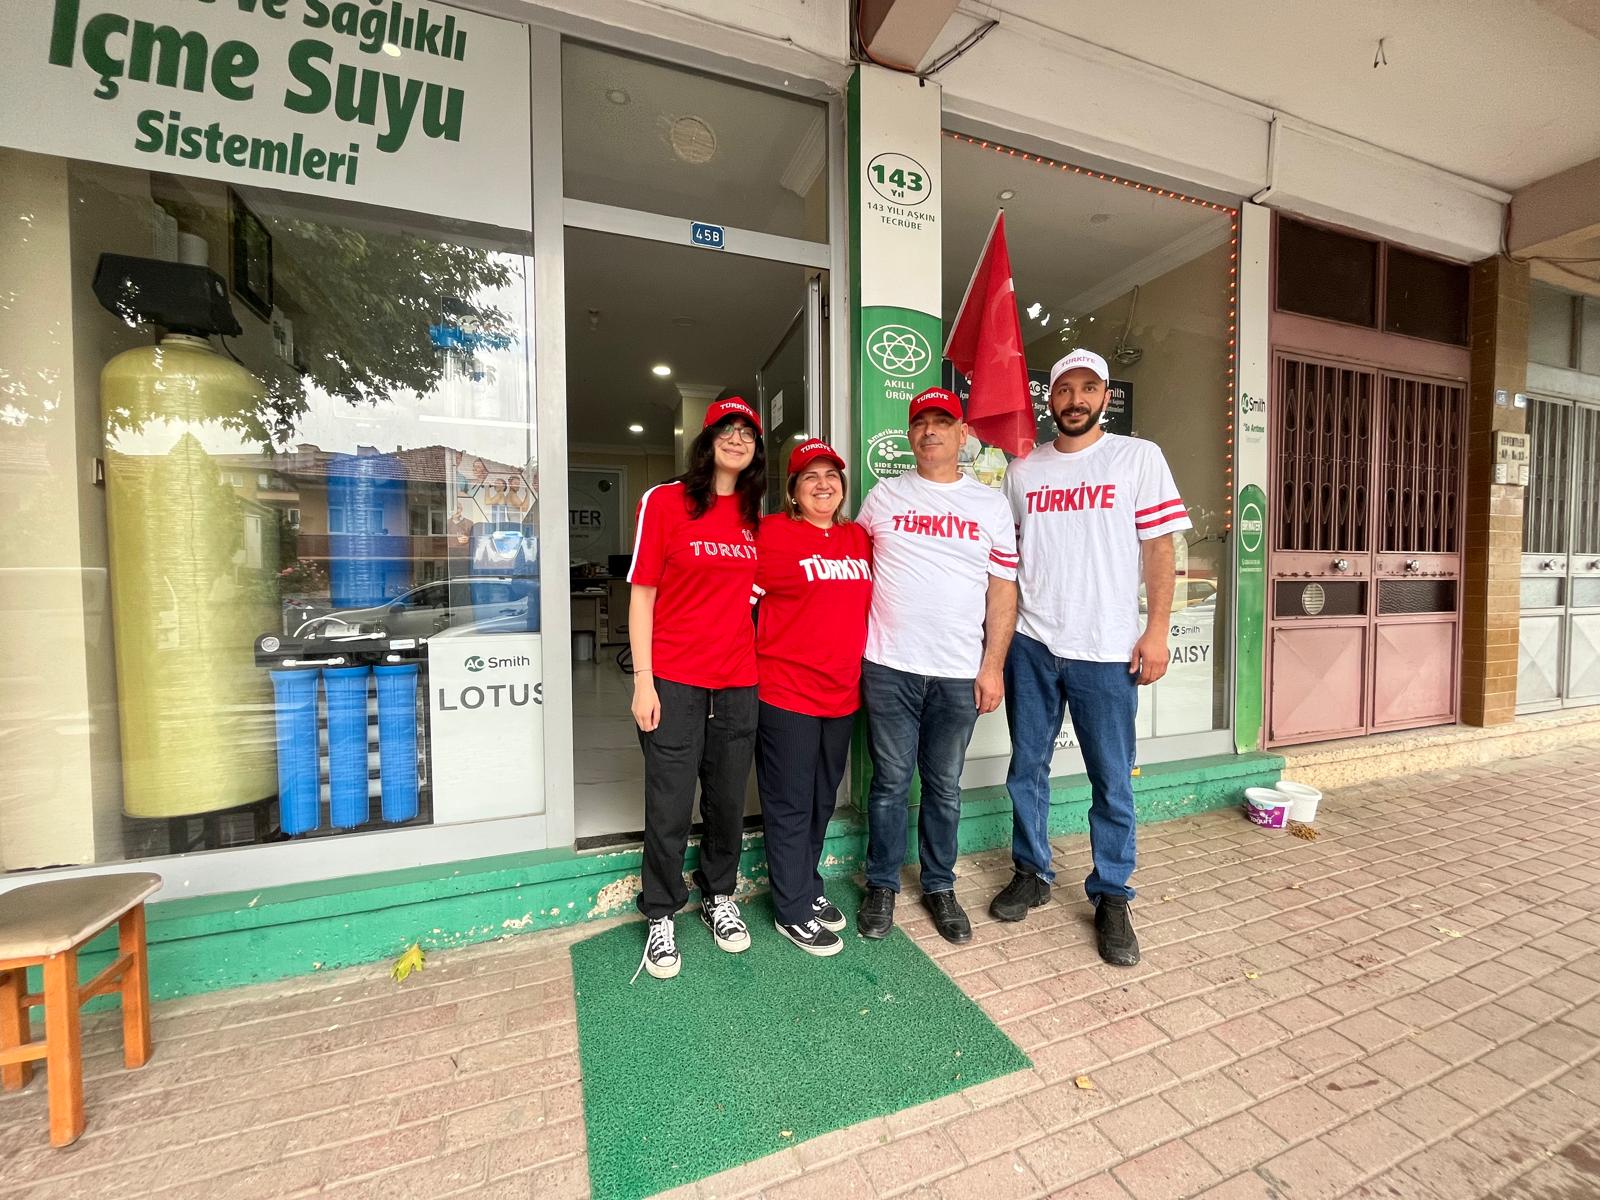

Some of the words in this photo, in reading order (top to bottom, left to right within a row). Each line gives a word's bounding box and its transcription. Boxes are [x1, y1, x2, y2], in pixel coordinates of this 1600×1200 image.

[284, 38, 465, 153] Suyu
[134, 109, 360, 186] Sistemleri
[871, 164, 923, 192] 143
[867, 201, 884, 212] 143
[887, 205, 904, 216] YILI
[906, 210, 935, 223] AŞKIN
[880, 215, 923, 231] TECRÜBE
[695, 227, 720, 242] 45B
[884, 380, 914, 390] AKILLI
[1107, 387, 1125, 398] mith
[885, 389, 913, 400] ÜRÜN
[1249, 397, 1265, 413] Smith
[1025, 481, 1116, 515] TÜRKİYE
[569, 509, 601, 525] TER
[891, 510, 980, 541] TÜRKİYE
[798, 554, 873, 583] TÜRKİY
[1180, 625, 1201, 635] Smith
[488, 655, 530, 669] Smith
[1168, 644, 1210, 664] AISY
